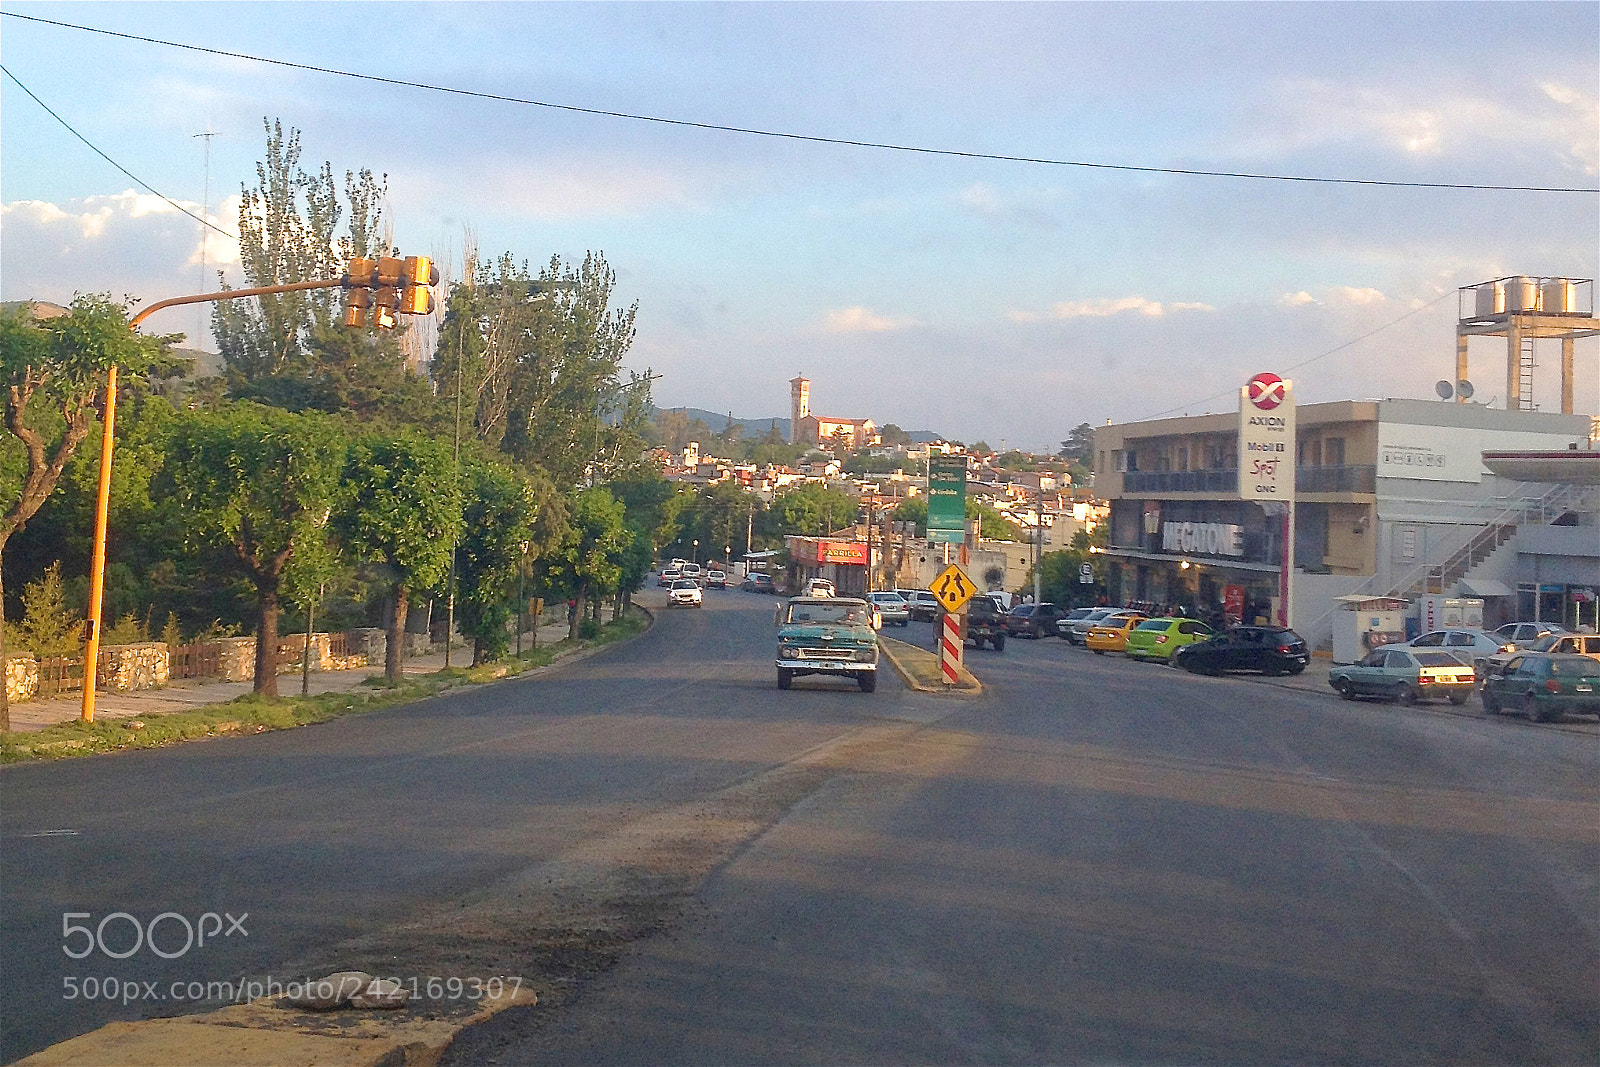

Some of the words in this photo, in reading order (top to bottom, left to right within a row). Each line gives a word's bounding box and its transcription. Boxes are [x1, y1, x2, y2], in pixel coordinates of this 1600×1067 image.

[1248, 416, 1285, 427] AXION
[1248, 442, 1274, 452] Mobil
[1255, 485, 1276, 493] GNC
[822, 548, 863, 558] PARRILLA
